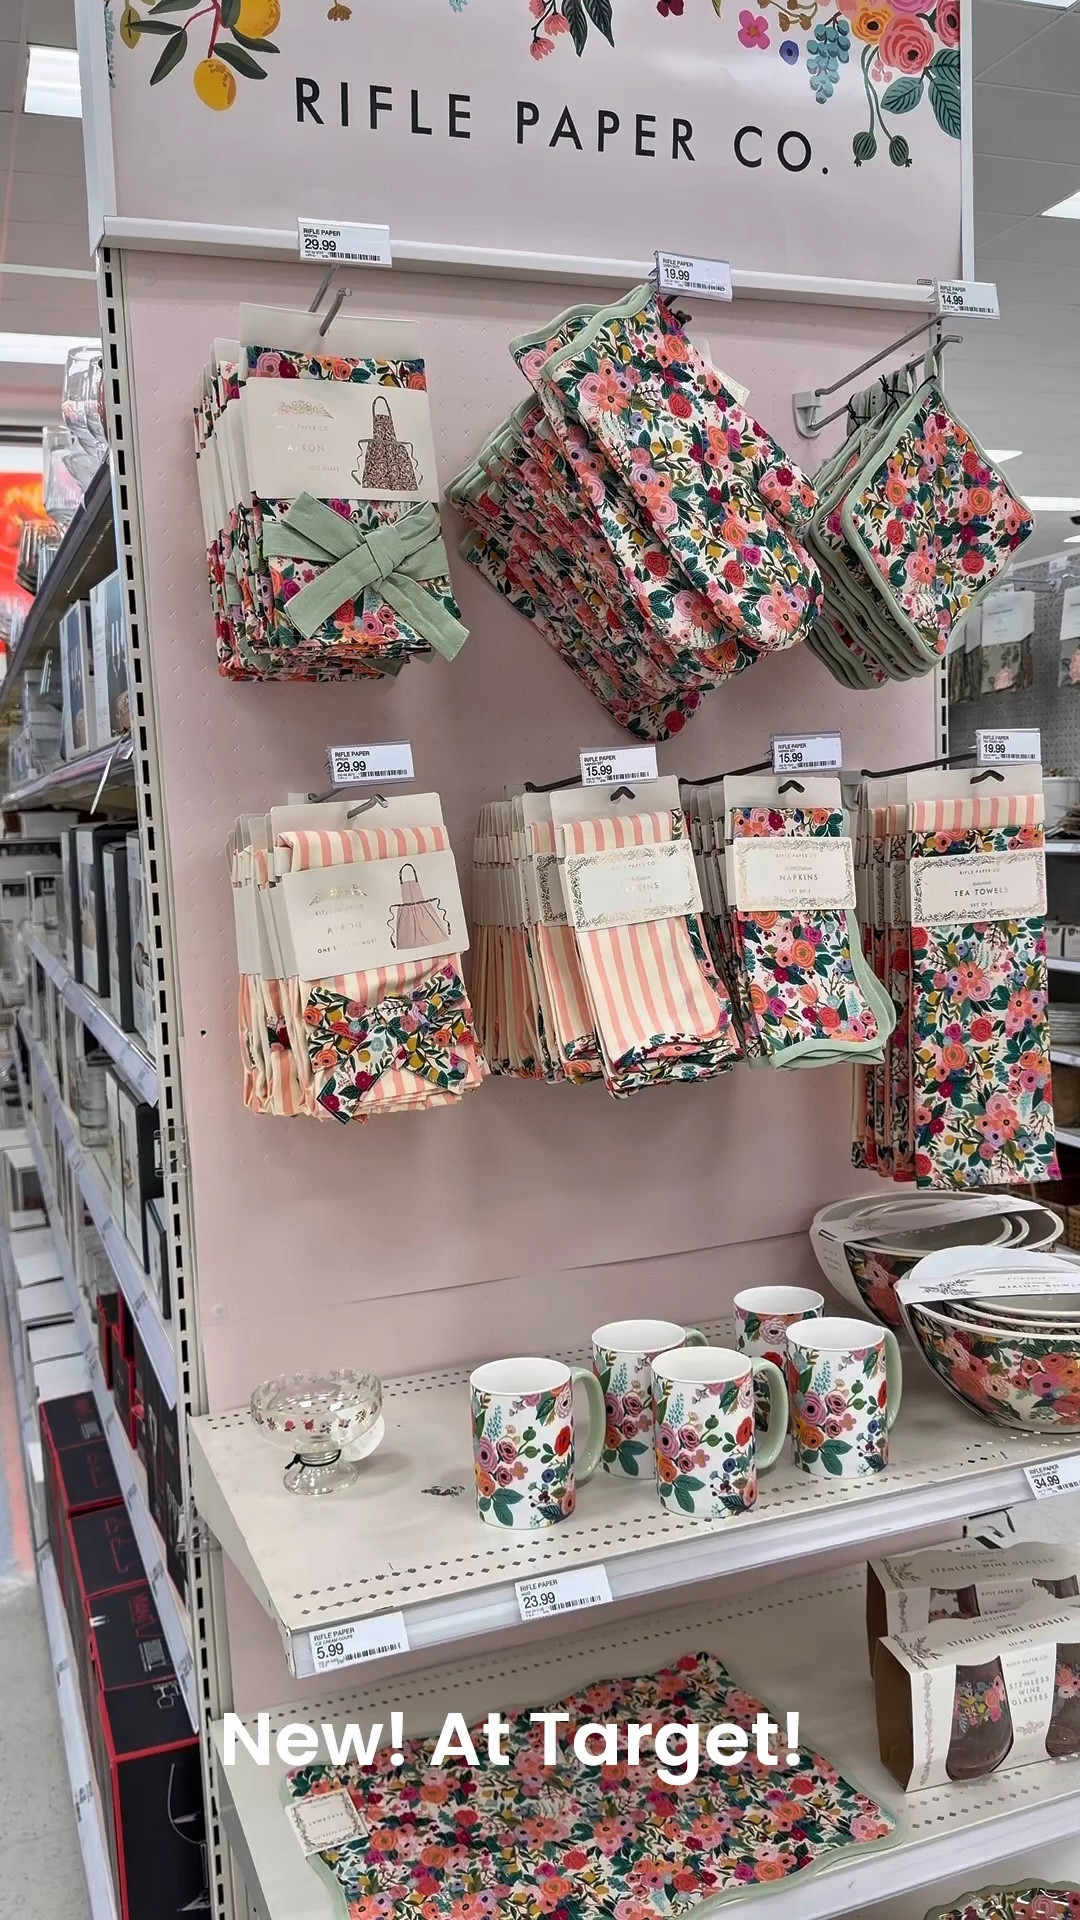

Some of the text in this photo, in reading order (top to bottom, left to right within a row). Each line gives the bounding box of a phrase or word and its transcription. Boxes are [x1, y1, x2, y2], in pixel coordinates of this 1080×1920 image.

[296, 76, 829, 175] RIFLE PAPER CO.
[304, 238, 337, 251] 29.99
[664, 268, 690, 281] 19.99
[942, 294, 964, 306] 14.99
[984, 744, 1006, 753] 19.99
[779, 753, 803, 763] 15.99
[336, 760, 366, 772] 29.99
[586, 765, 612, 776] 15.99
[975, 887, 1008, 896] TOWELS
[1034, 1475, 1060, 1489] 34.99
[520, 1579, 558, 1592] RIFLE PAPER
[523, 1592, 556, 1610] 23.99
[314, 1627, 355, 1642] RIFLE PAPER
[947, 1616, 1070, 1647] STEMLESS WINE GLASSES
[316, 1642, 344, 1660] 5.99
[1009, 1675, 1049, 1690] STEMLESS
[1019, 1686, 1040, 1695] WINE
[1012, 1693, 1048, 1706] GLASSES
